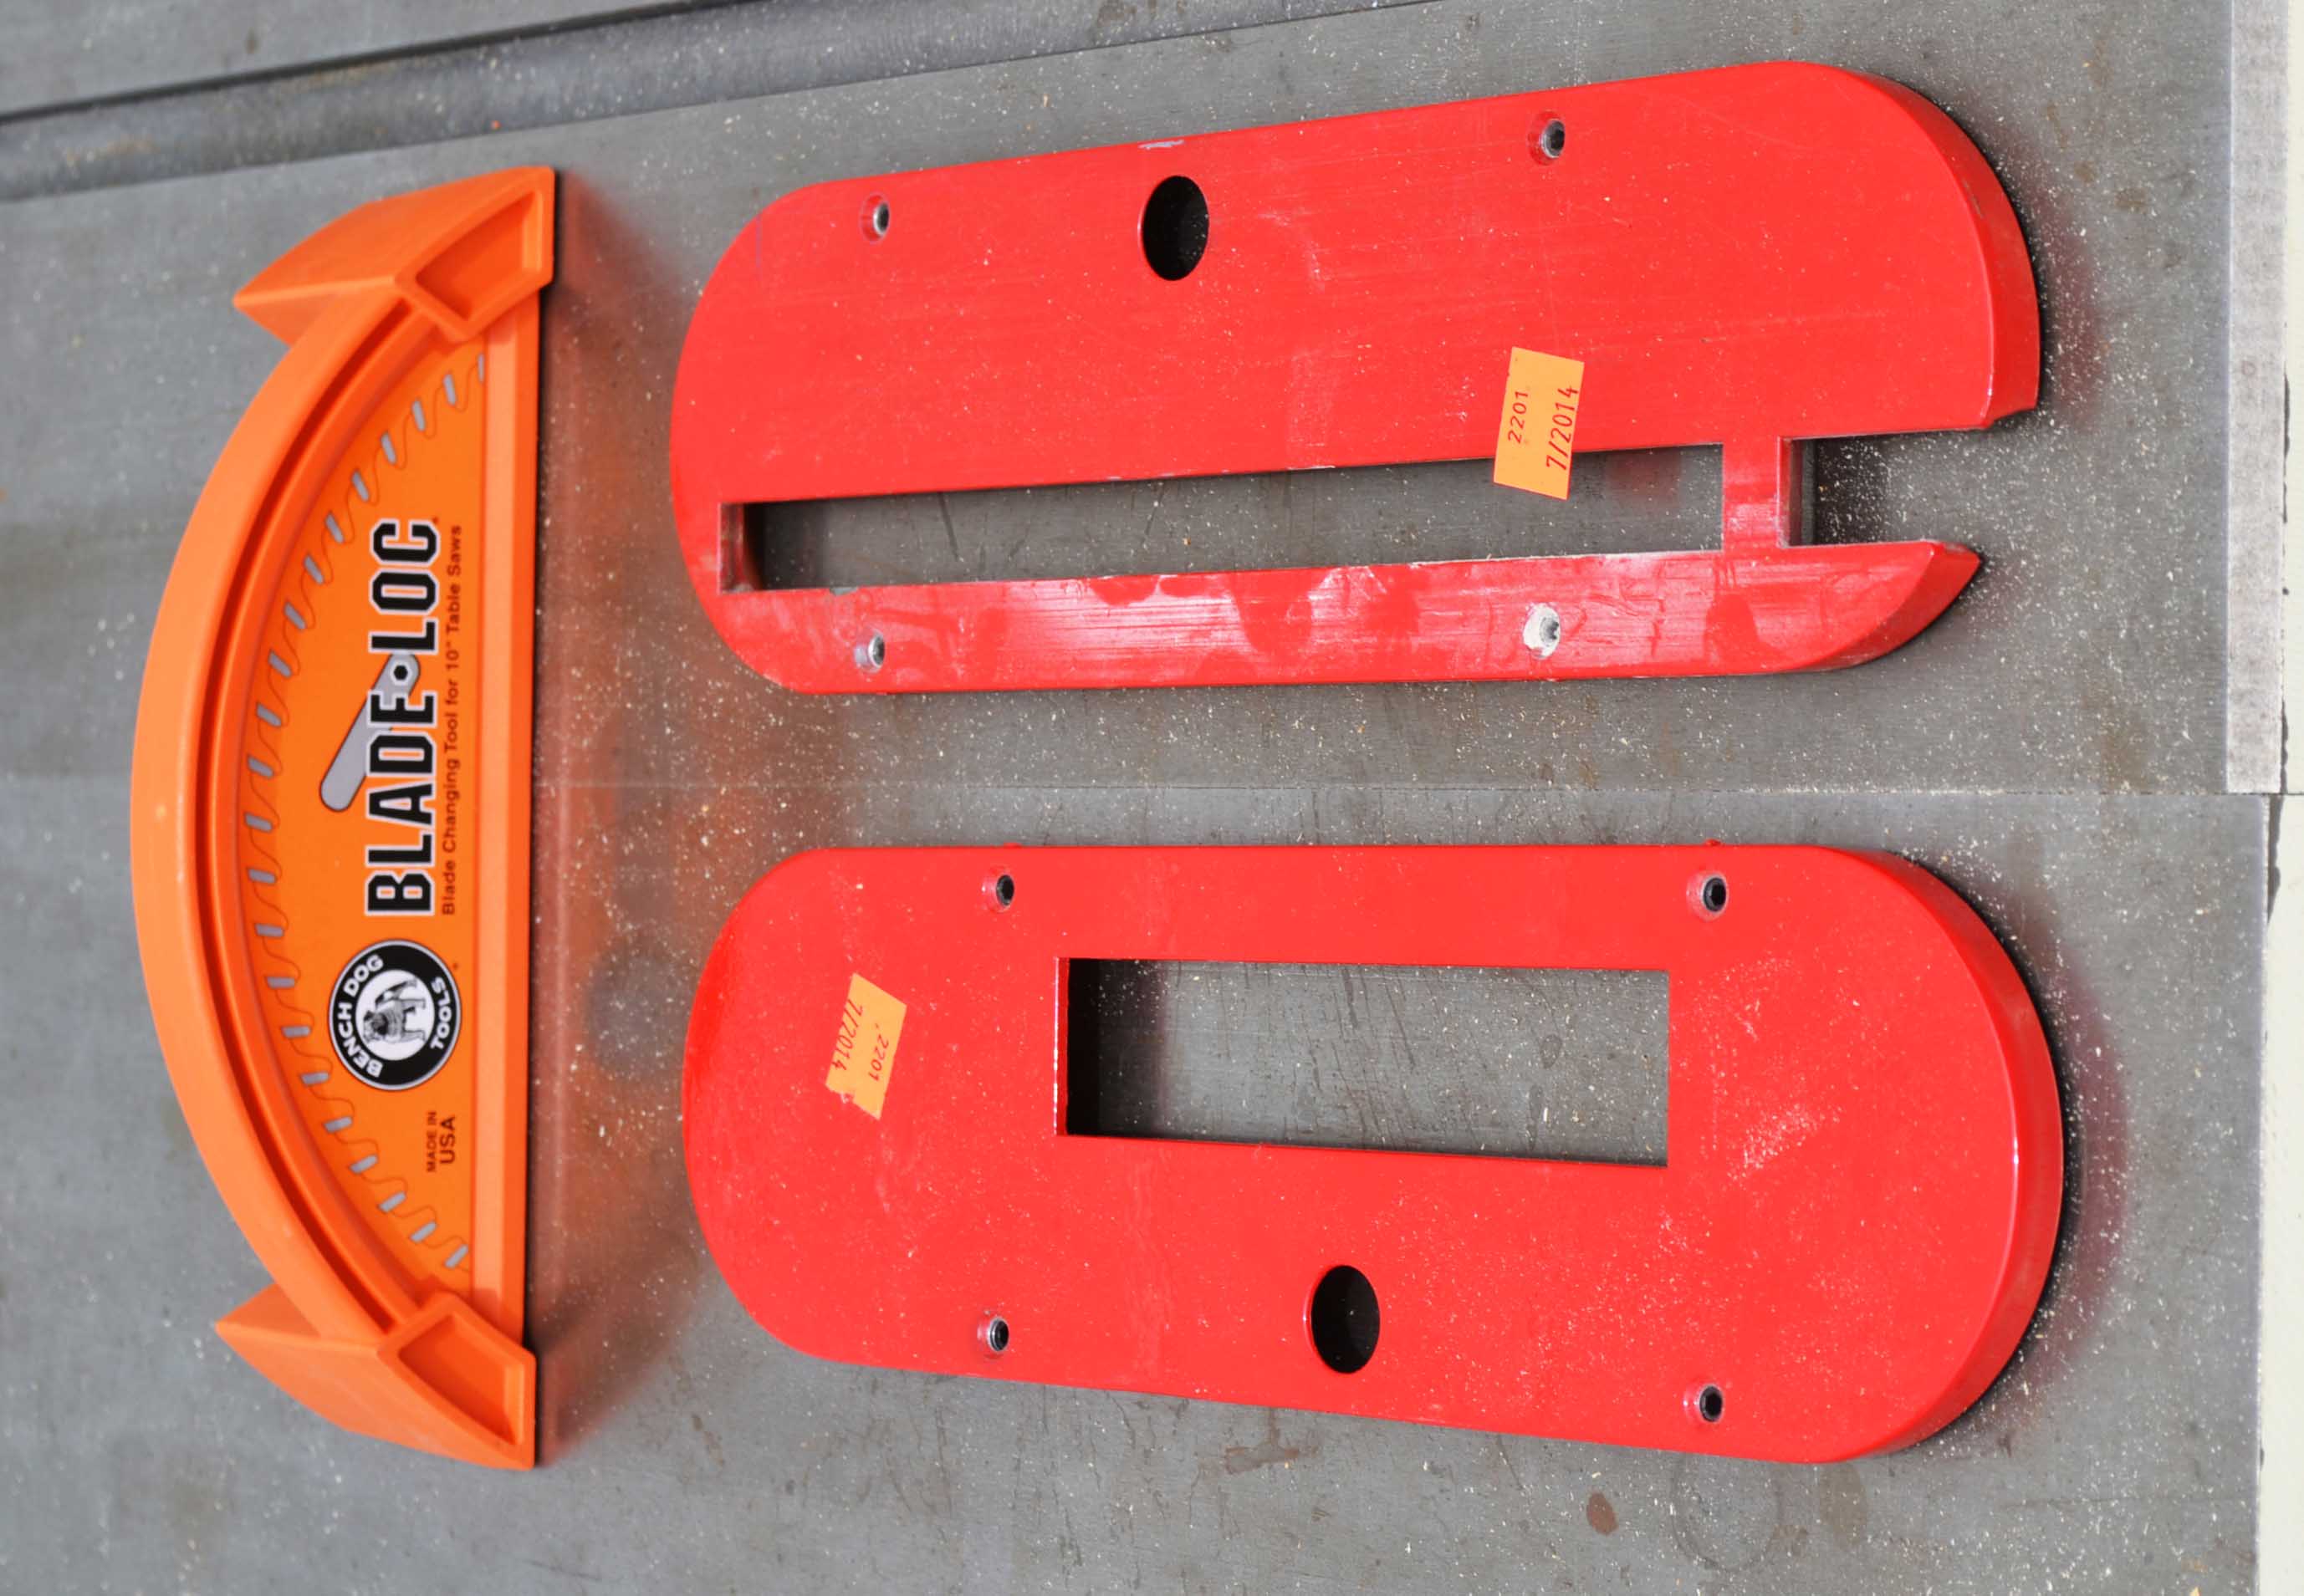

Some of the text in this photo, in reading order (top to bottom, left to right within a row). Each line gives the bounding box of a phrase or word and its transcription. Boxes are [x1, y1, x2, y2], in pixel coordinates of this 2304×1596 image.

[1507, 390, 1529, 444] 2201
[1545, 388, 1580, 471] 7/2014
[447, 525, 462, 577] Saws
[446, 585, 461, 636] Table
[445, 679, 459, 706] for
[444, 712, 459, 754] Tool
[442, 757, 460, 854] Changing
[442, 859, 456, 915] Blade
[337, 954, 384, 1078] BENCH DOG
[430, 976, 452, 1051] TOOLS
[831, 998, 863, 1071] 7/2014
[868, 1033, 889, 1082] 2201
[426, 1111, 437, 1172] MADE IN
[439, 1116, 456, 1165] USA
